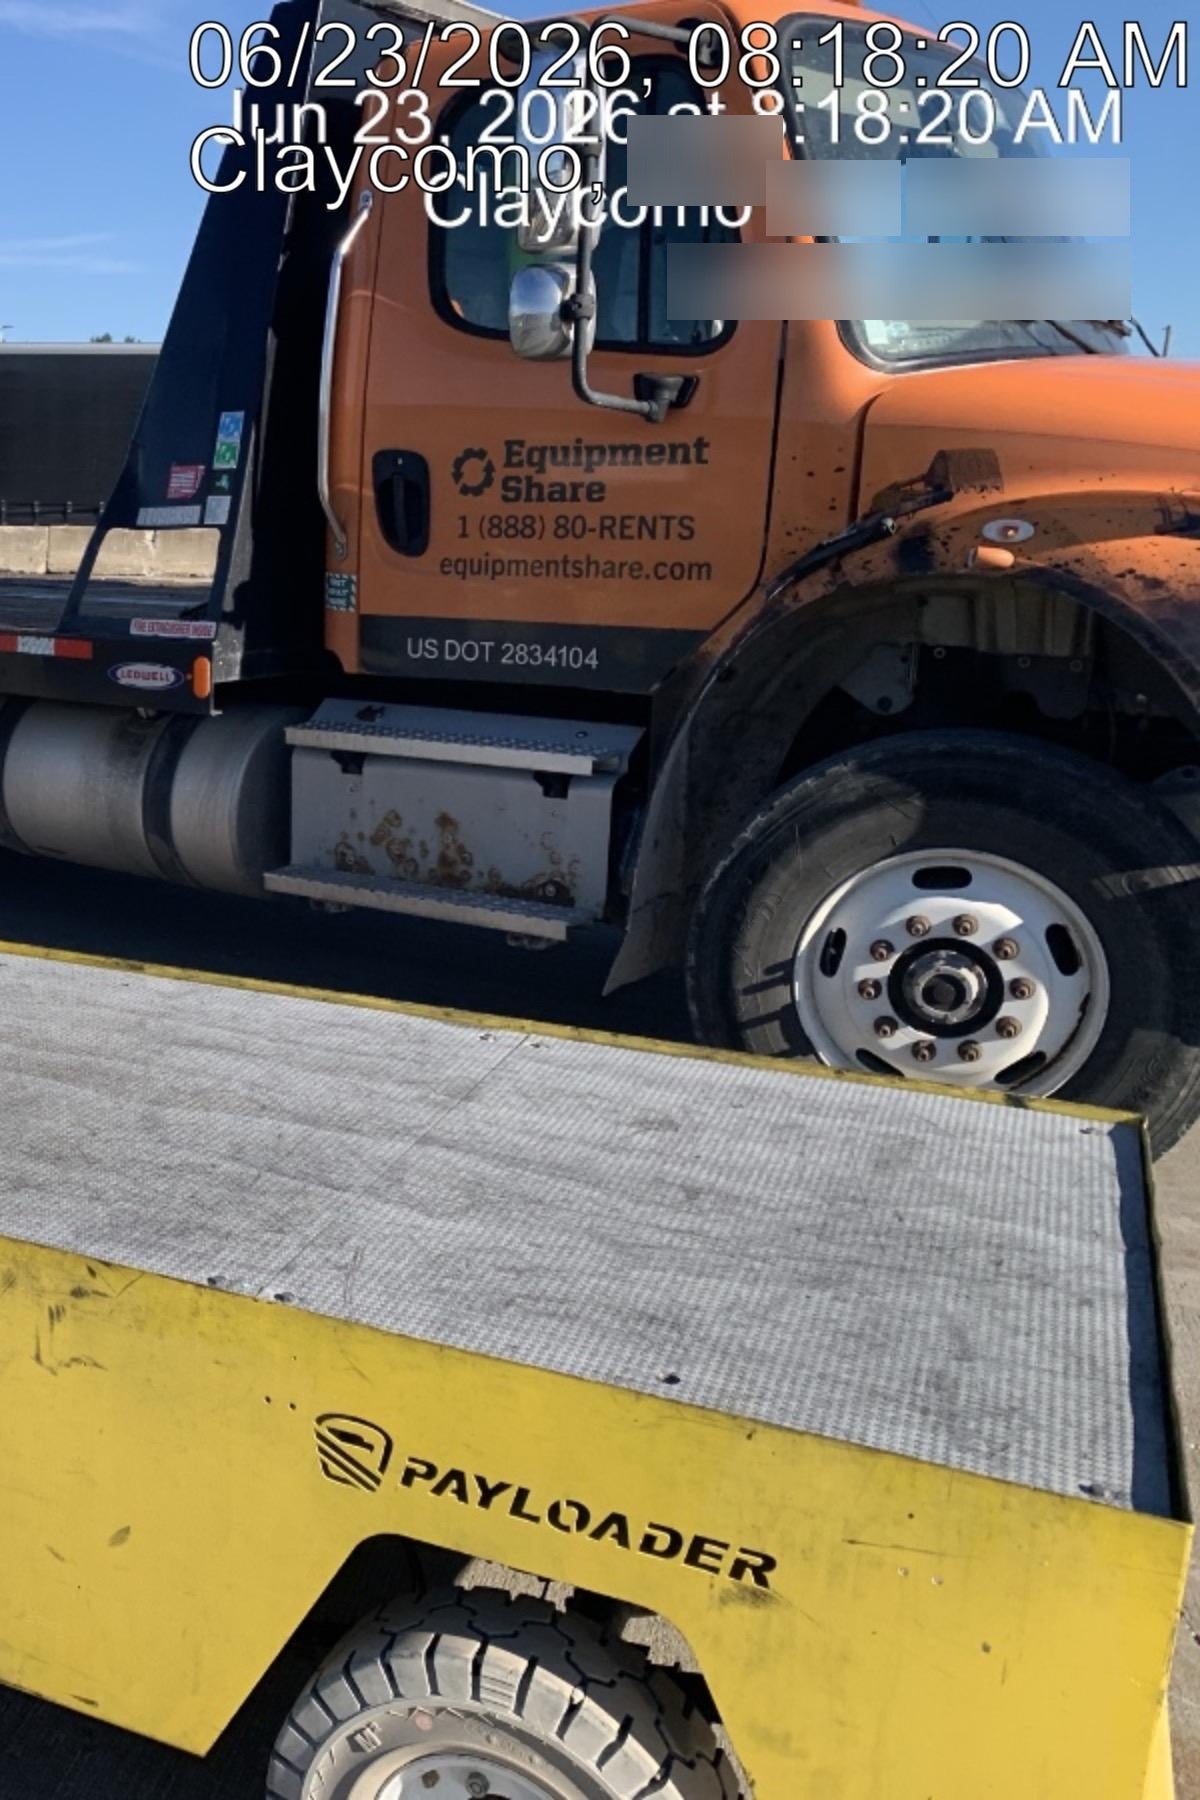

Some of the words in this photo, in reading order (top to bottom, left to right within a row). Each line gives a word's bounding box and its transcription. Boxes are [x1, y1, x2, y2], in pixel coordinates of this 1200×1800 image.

[503, 437, 710, 474] Equipment
[501, 475, 606, 503] Share
[457, 515, 469, 538] 1
[479, 514, 545, 540] (888)
[553, 515, 695, 541] 80-RENTS
[440, 552, 712, 581] equipmentshare.com
[407, 638, 439, 659] US
[445, 640, 495, 662] DOT
[501, 643, 599, 669] 2834104
[400, 1457, 778, 1588] PAYLOADER
